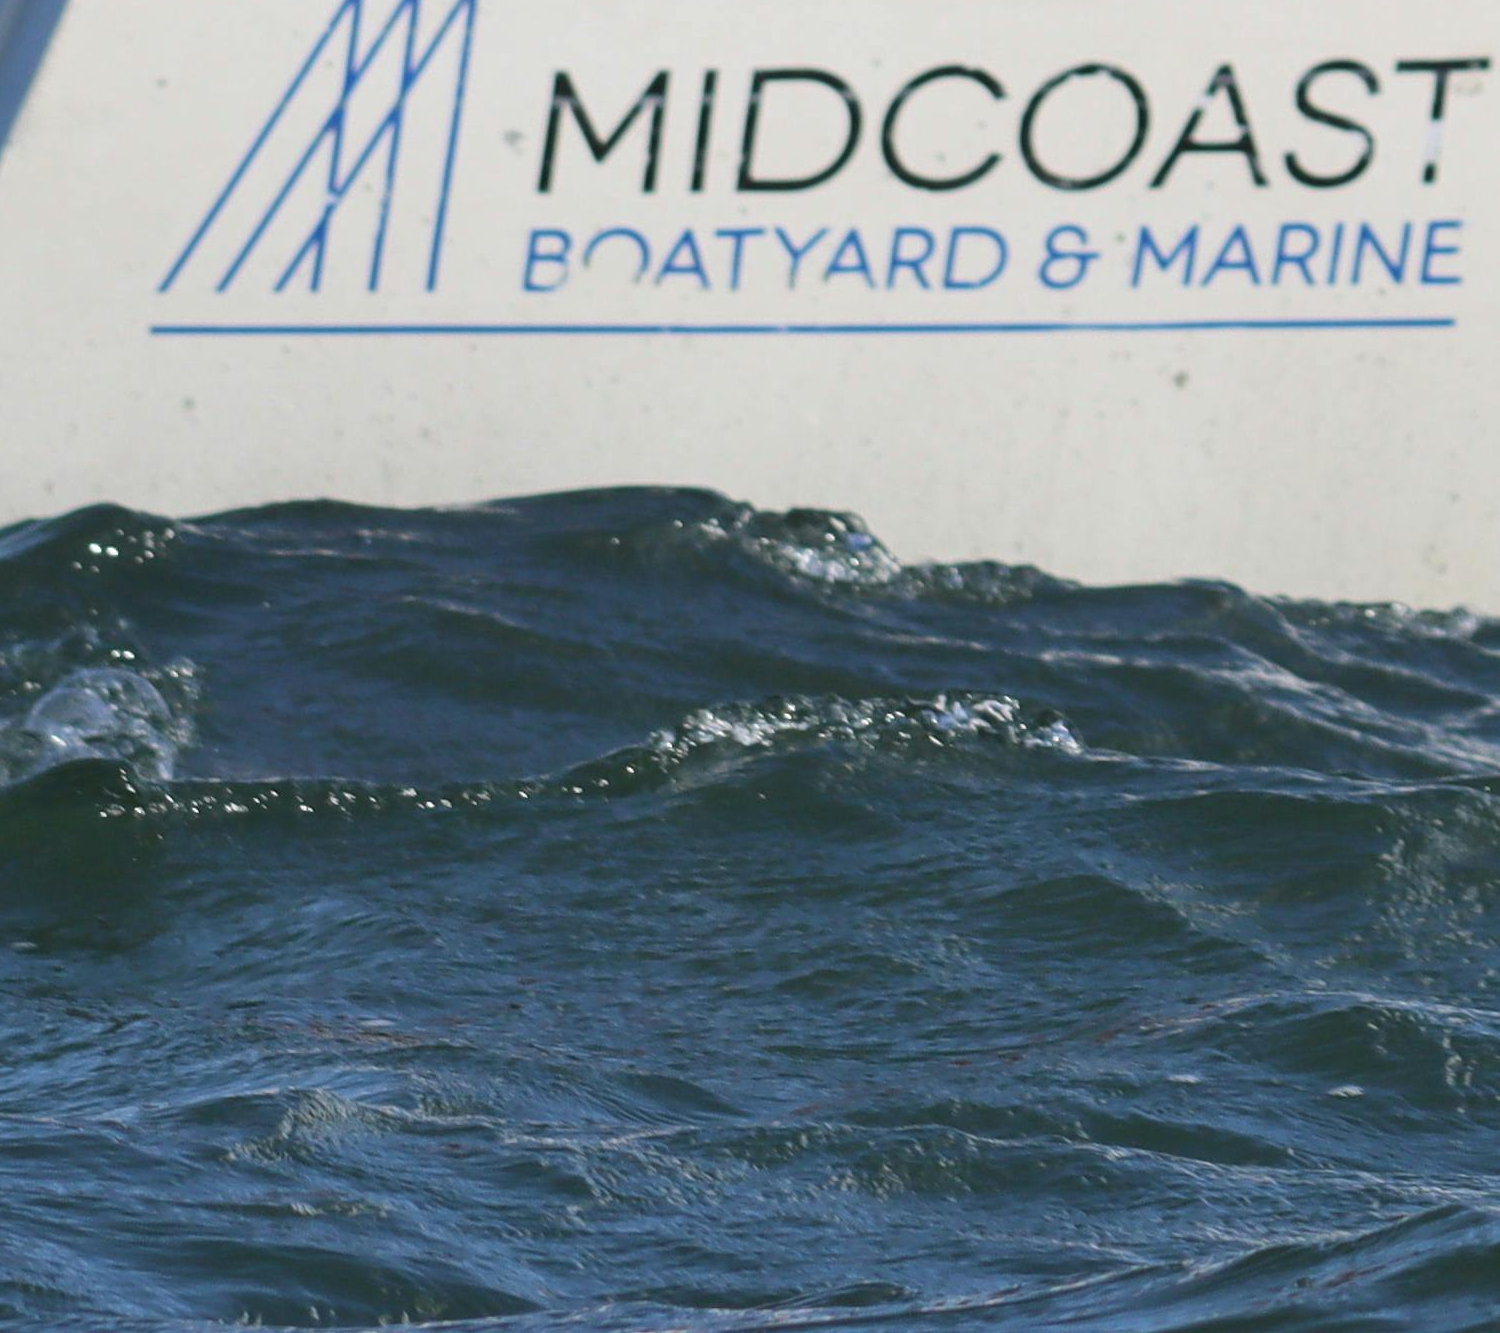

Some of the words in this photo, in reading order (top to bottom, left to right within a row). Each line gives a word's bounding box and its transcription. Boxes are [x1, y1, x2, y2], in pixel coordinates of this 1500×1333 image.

[535, 56, 1493, 195] MIDCOAST
[520, 225, 1010, 294] BOATYARD
[1037, 222, 1102, 292] &
[1129, 218, 1464, 290] MARINE
